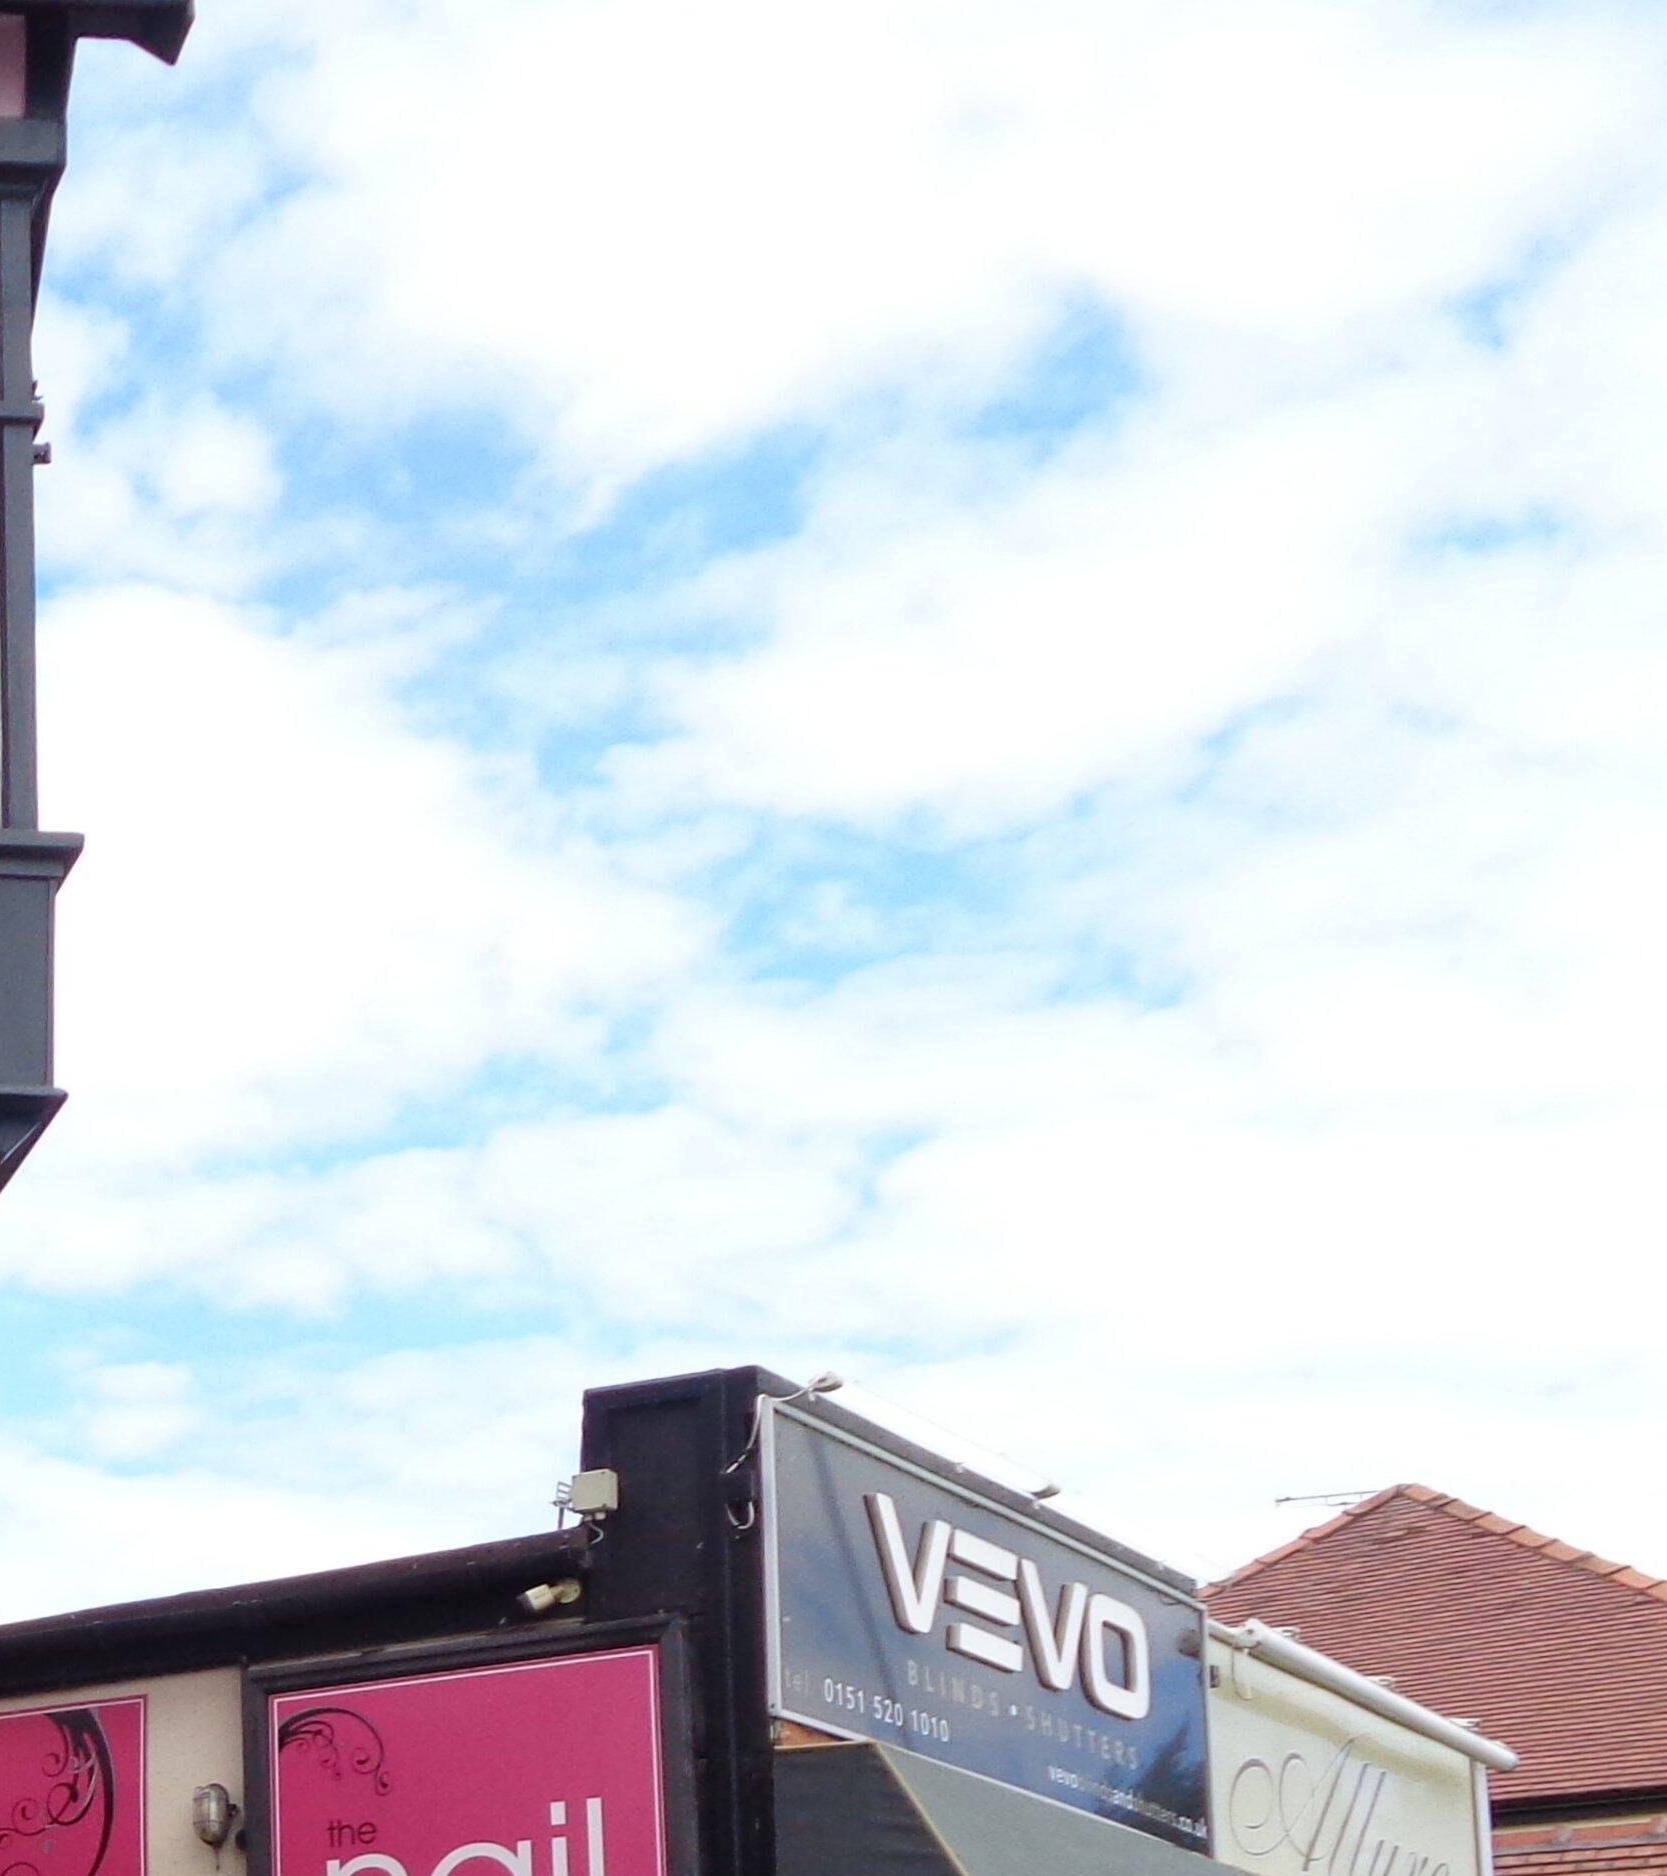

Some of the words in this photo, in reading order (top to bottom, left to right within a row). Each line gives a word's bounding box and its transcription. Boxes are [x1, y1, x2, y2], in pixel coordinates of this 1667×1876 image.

[865, 1492, 1150, 1720] VEVO
[824, 1678, 864, 1713] 0151
[873, 1696, 903, 1726] 520
[911, 1710, 949, 1742] 1010
[907, 1659, 999, 1717] BLINDS
[1026, 1707, 1137, 1770] SHUTTERS
[327, 1820, 376, 1847] the
